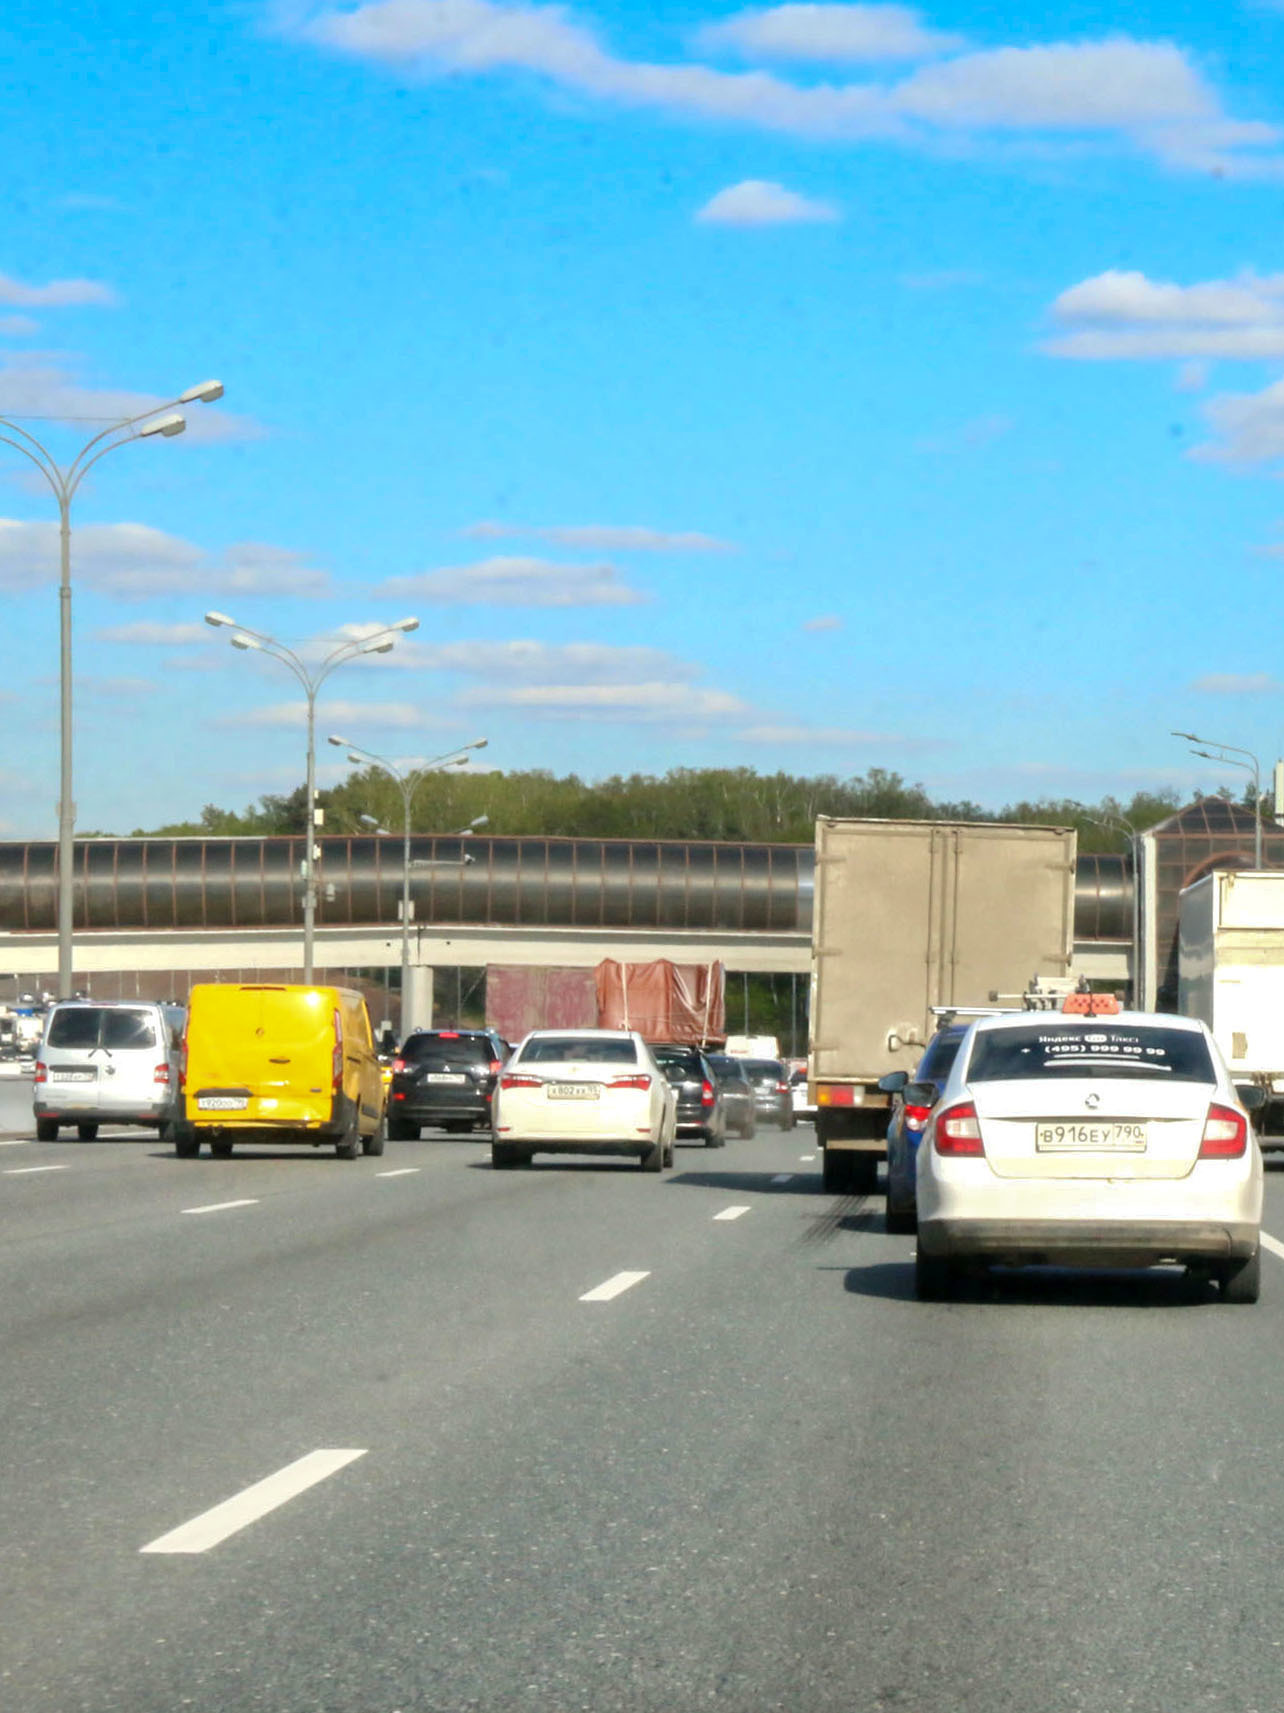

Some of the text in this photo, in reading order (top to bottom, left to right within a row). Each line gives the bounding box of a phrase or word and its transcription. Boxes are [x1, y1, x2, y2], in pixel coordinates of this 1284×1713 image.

[1038, 1035, 1081, 1044] Яндекс
[1044, 1044, 1086, 1054] (495)
[1090, 1044, 1119, 1053] 999
[1122, 1045, 1143, 1054] 99
[1146, 1047, 1166, 1056] 99
